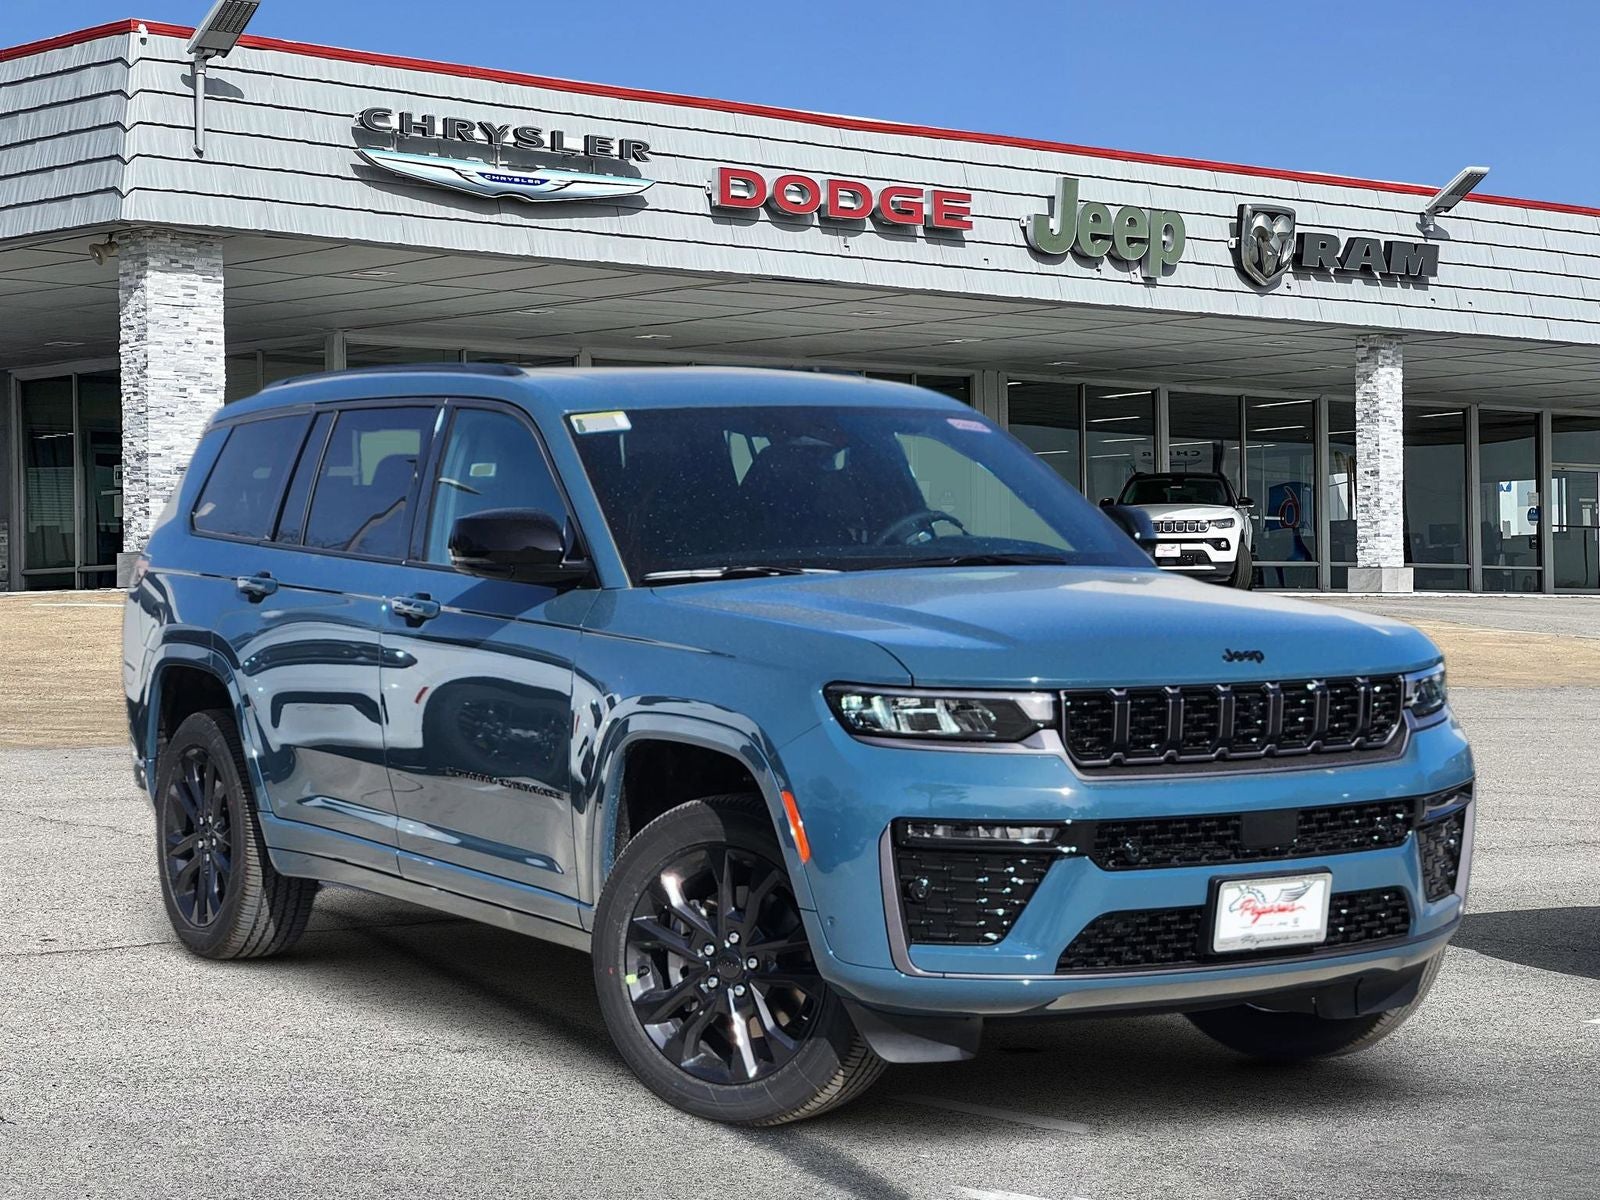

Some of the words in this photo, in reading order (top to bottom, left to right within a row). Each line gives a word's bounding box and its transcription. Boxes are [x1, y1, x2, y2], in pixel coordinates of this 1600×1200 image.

[358, 106, 651, 163] CHRYSLER
[484, 174, 541, 185] CHRYSLER
[712, 166, 974, 231] DODGE
[1026, 176, 1187, 279] Jeep
[1296, 231, 1440, 278] RAM
[1222, 647, 1265, 665] Jeep
